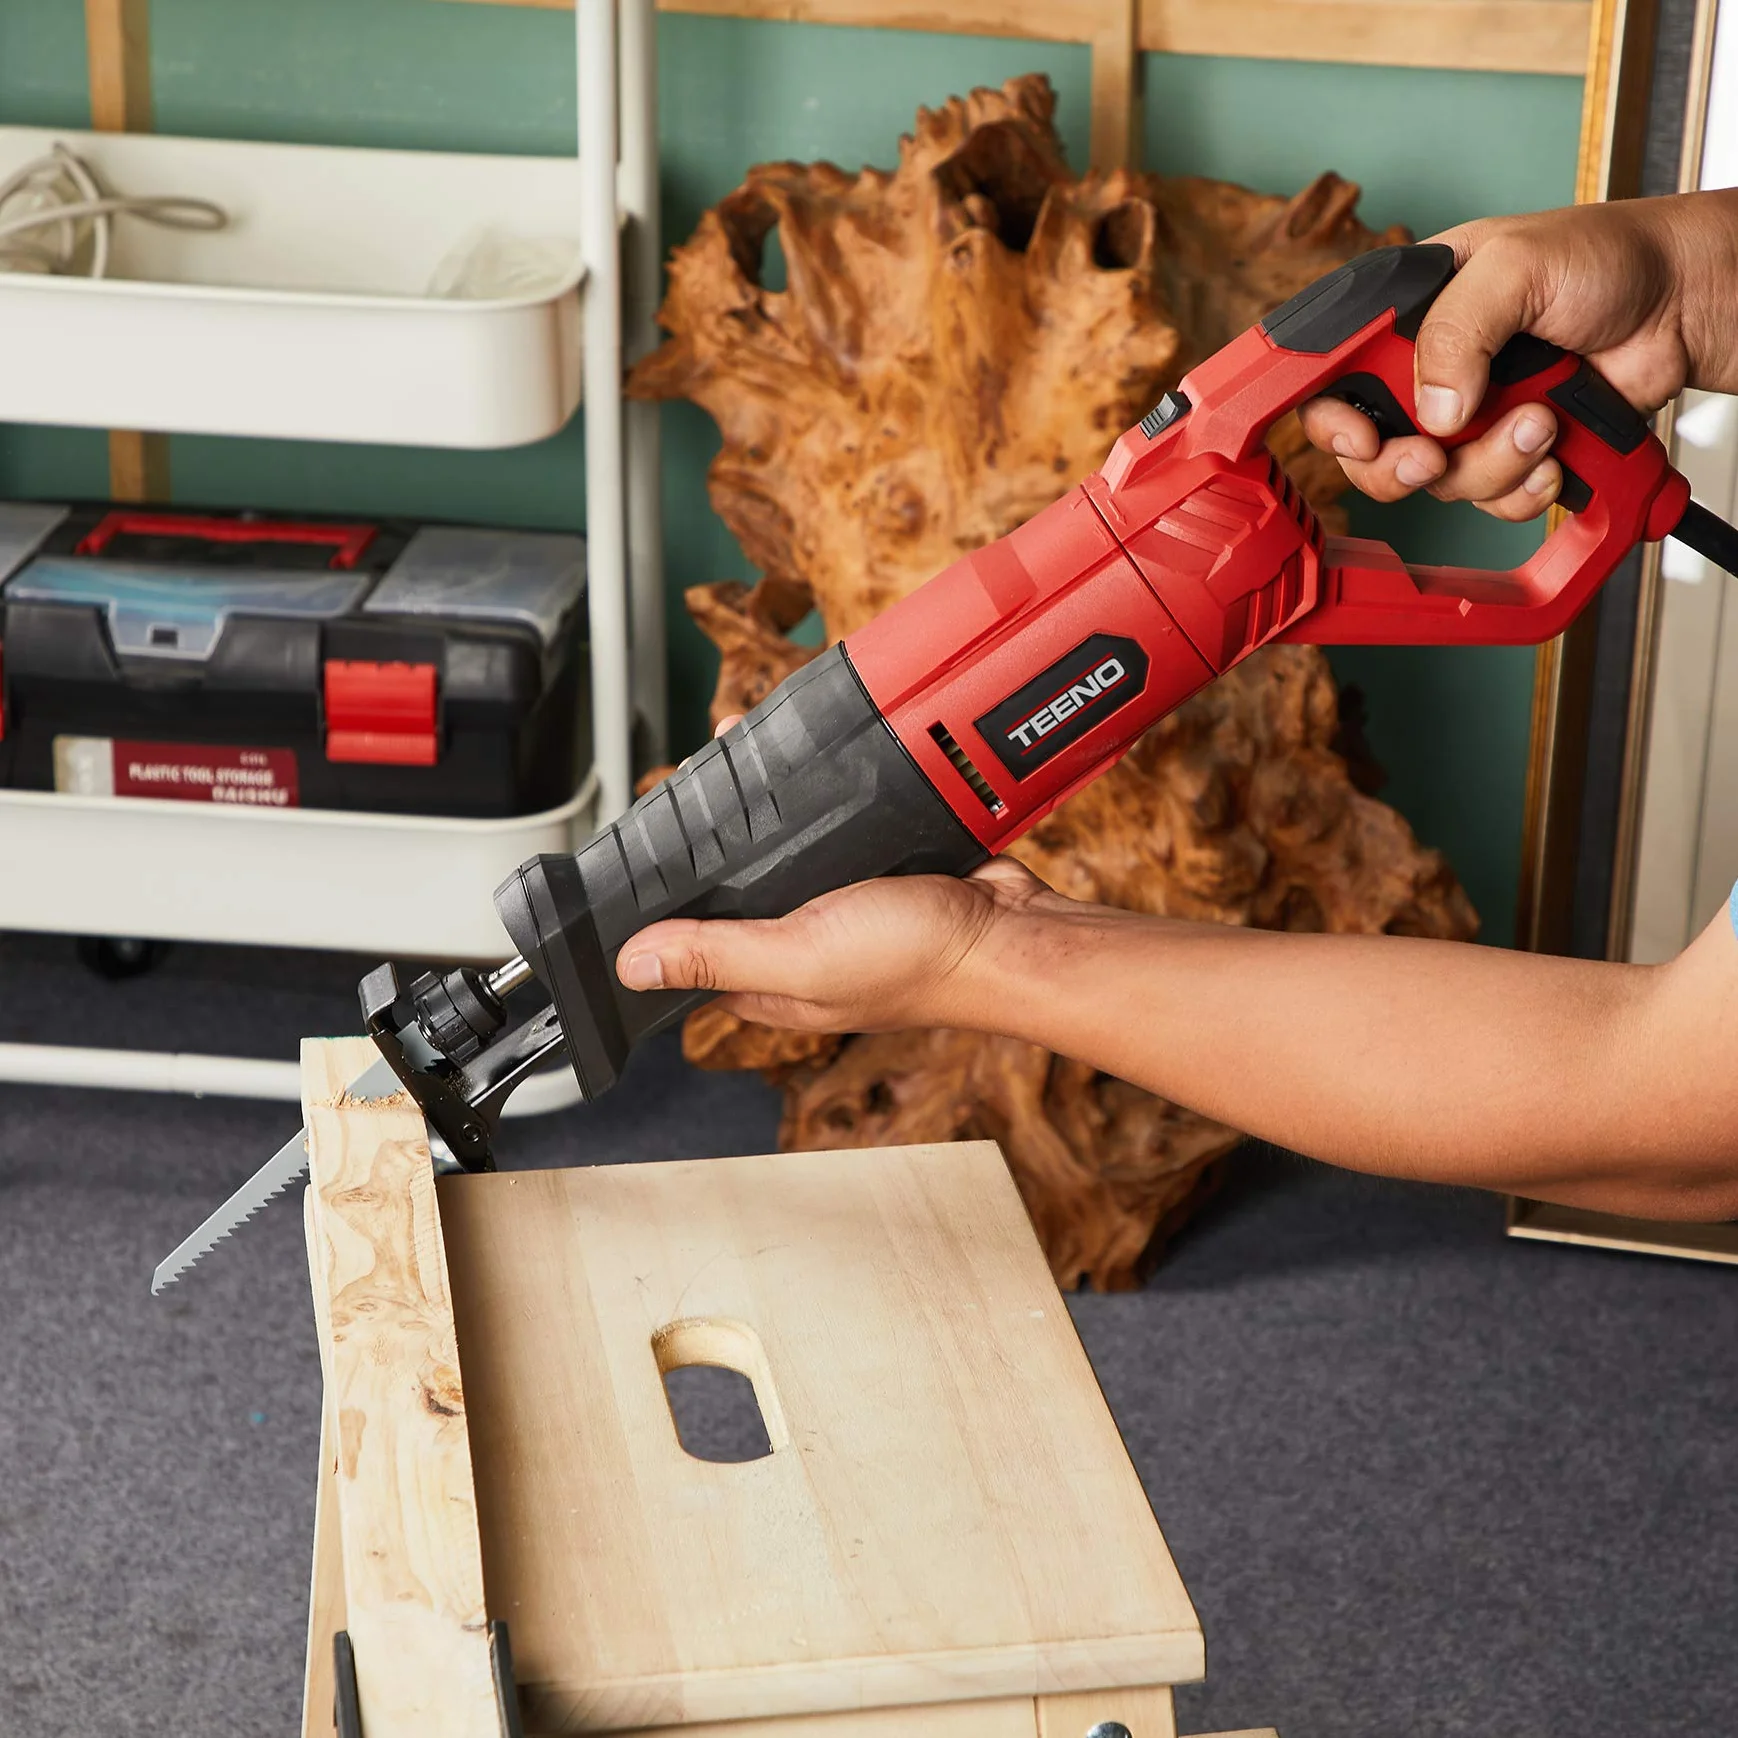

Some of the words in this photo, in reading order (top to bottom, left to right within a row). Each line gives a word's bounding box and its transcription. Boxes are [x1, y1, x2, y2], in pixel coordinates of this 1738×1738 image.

[1007, 658, 1125, 747] TEENO
[129, 763, 179, 782] PLASTIC
[183, 765, 214, 785] TOOL
[215, 768, 274, 787] STORAGE
